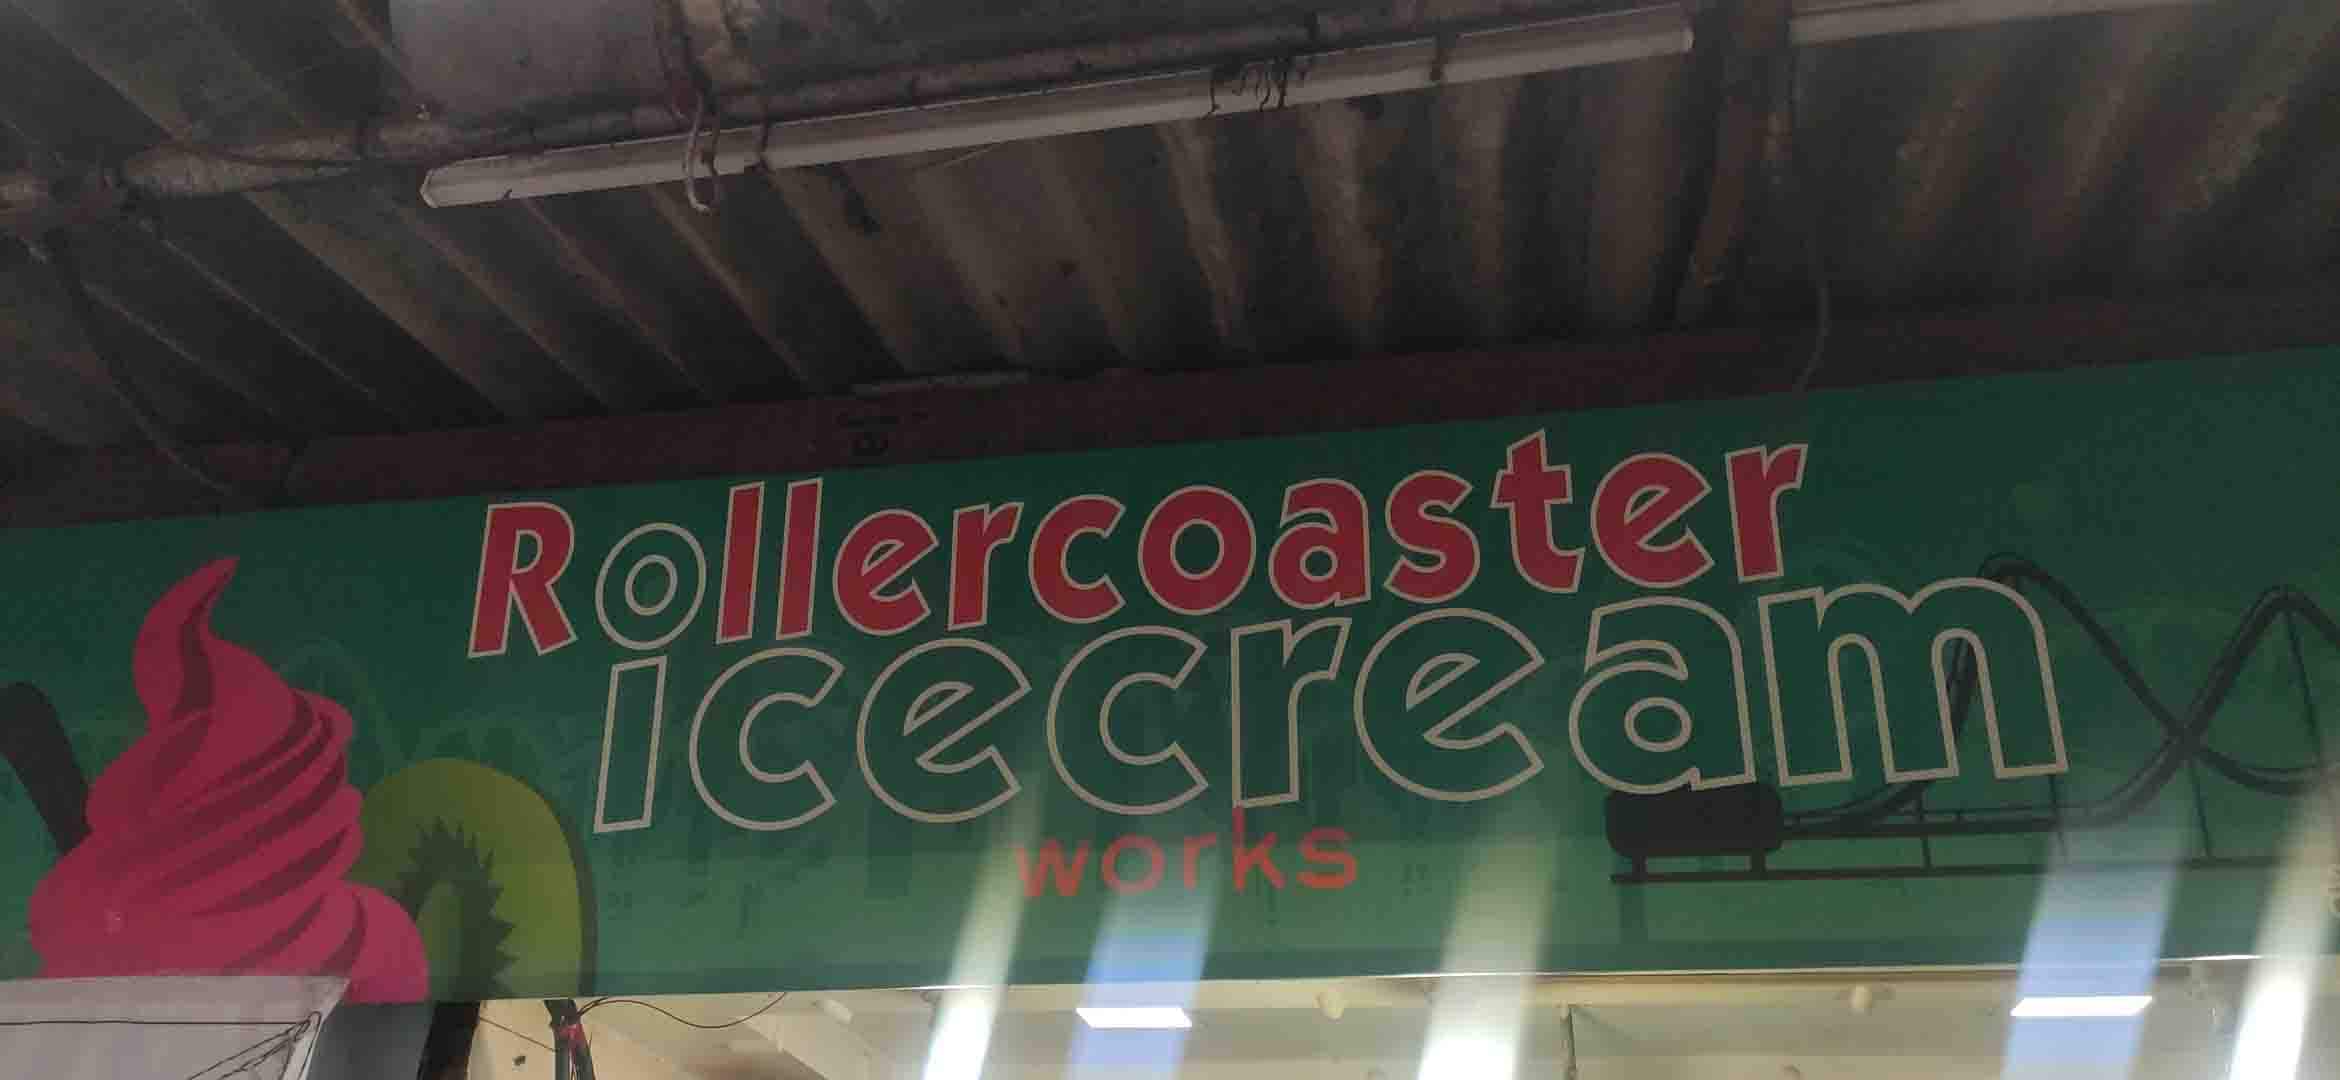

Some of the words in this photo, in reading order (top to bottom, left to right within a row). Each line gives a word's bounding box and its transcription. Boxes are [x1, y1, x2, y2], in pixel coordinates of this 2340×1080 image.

[468, 429, 1808, 658] Rollercoaster
[593, 577, 2068, 832] icecream
[1014, 804, 1358, 897] works
